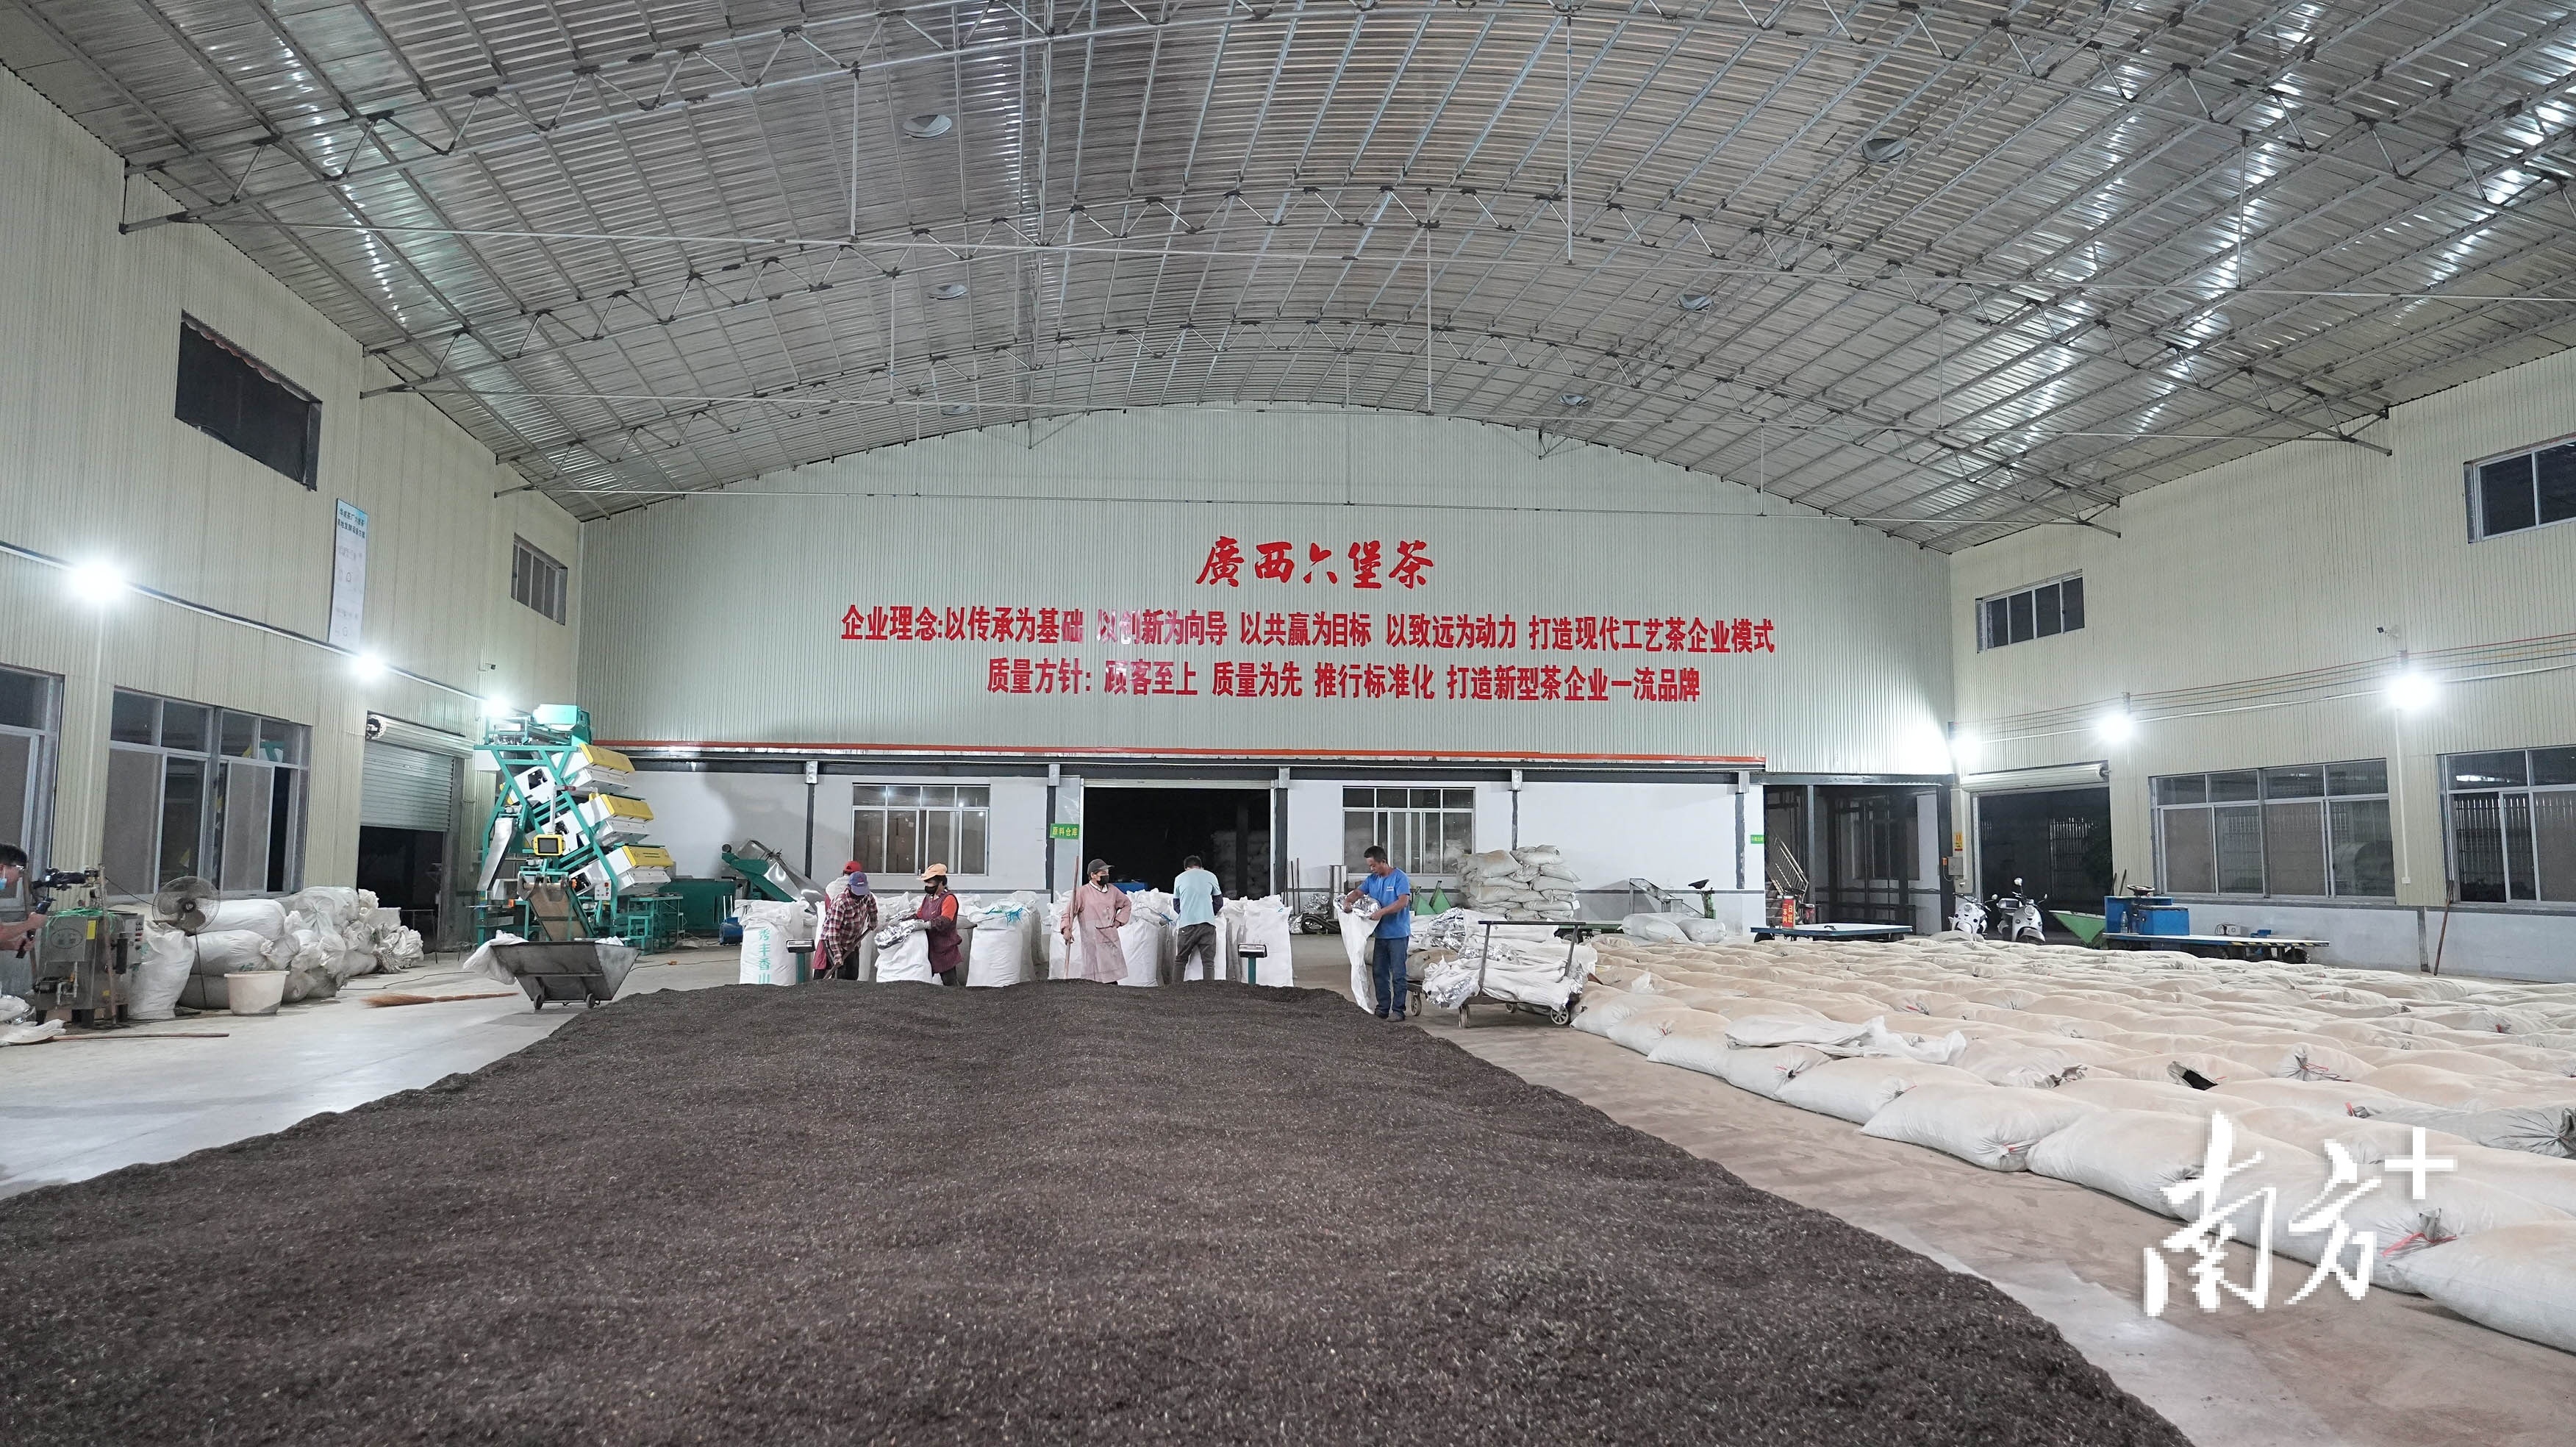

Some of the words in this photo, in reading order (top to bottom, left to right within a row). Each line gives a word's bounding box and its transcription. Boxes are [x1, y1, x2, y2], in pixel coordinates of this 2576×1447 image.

[1195, 535, 1434, 590] 廣西六堡茶
[840, 604, 1084, 645] 企业理念:以传承为基础
[1096, 609, 1228, 646] 以创新为向导
[1240, 611, 1372, 648] 以共赢为目标
[1386, 613, 1517, 649] 以致远为动力
[1528, 615, 1776, 654] 打造现代工艺茶企业模式
[1212, 661, 1303, 698] 质量为先
[1314, 661, 1436, 701] 推行标准化
[1446, 664, 1701, 703] 打造新型茶企业一流品牌
[1052, 826, 1078, 837] 原料仓库
